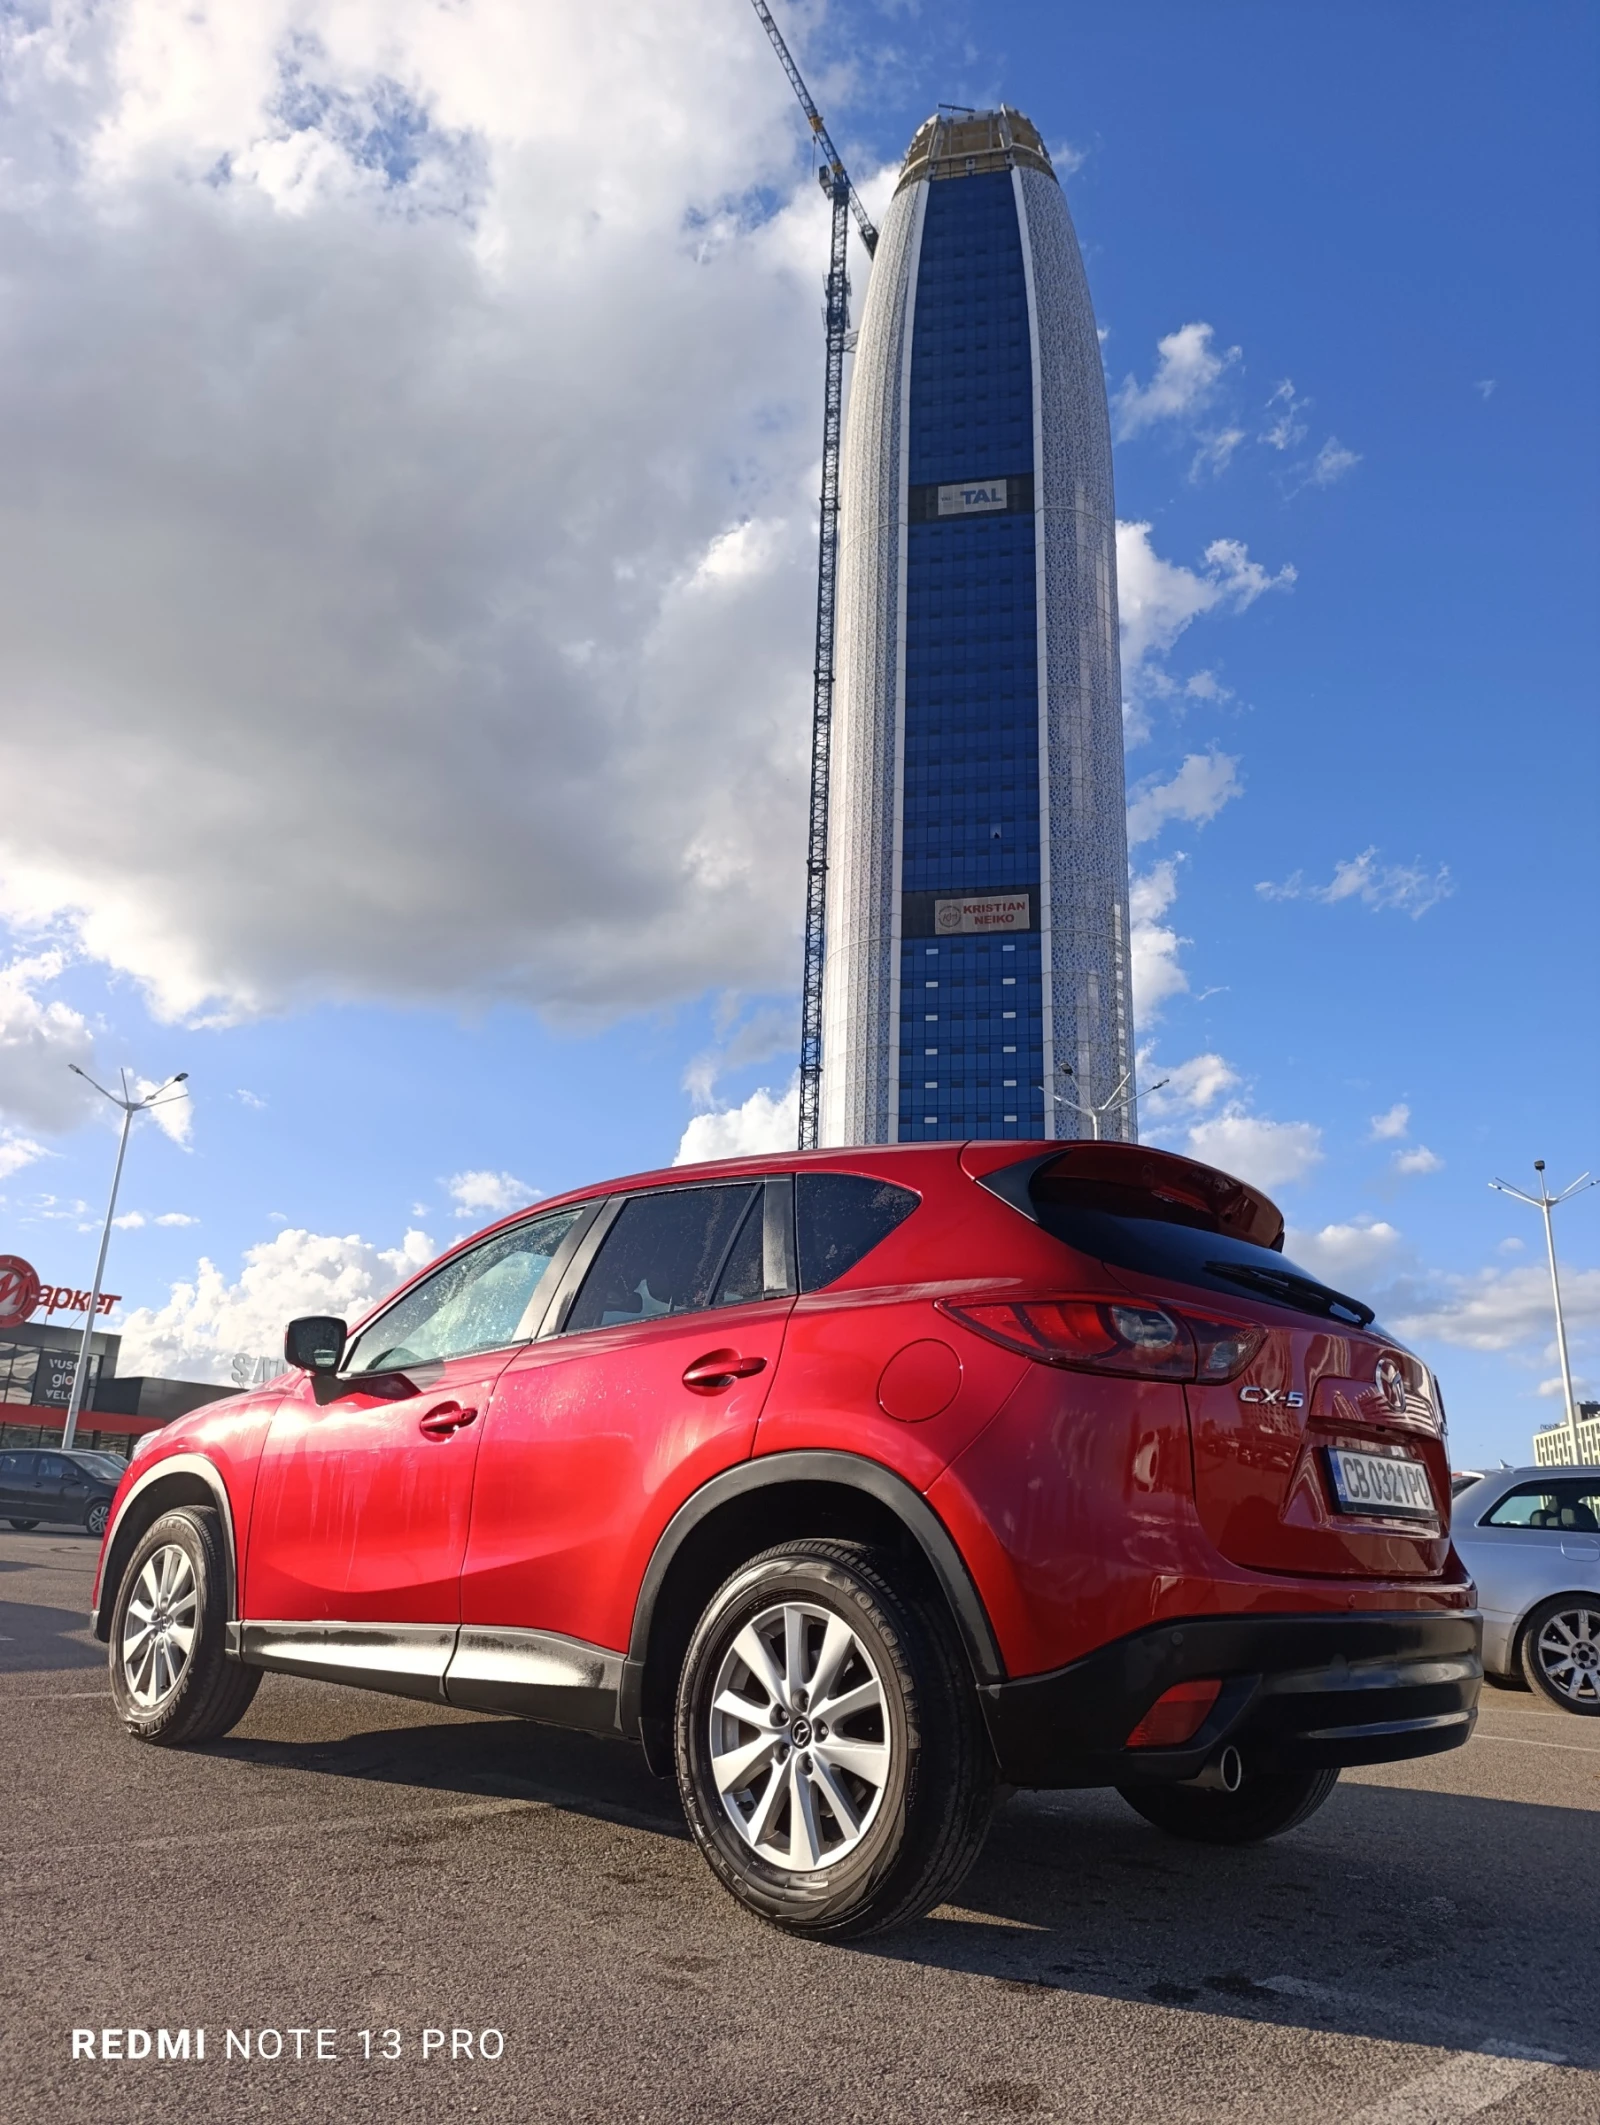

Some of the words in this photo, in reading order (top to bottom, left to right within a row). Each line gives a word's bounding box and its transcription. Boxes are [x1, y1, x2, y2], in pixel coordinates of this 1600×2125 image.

[960, 488, 1003, 505] TAL
[963, 902, 1026, 914] KRISTIAN
[974, 914, 1015, 925] NEIKO
[52, 1372, 74, 1388] glo
[1239, 1386, 1304, 1409] CX-5
[842, 1577, 921, 1749] YOKOHAMA
